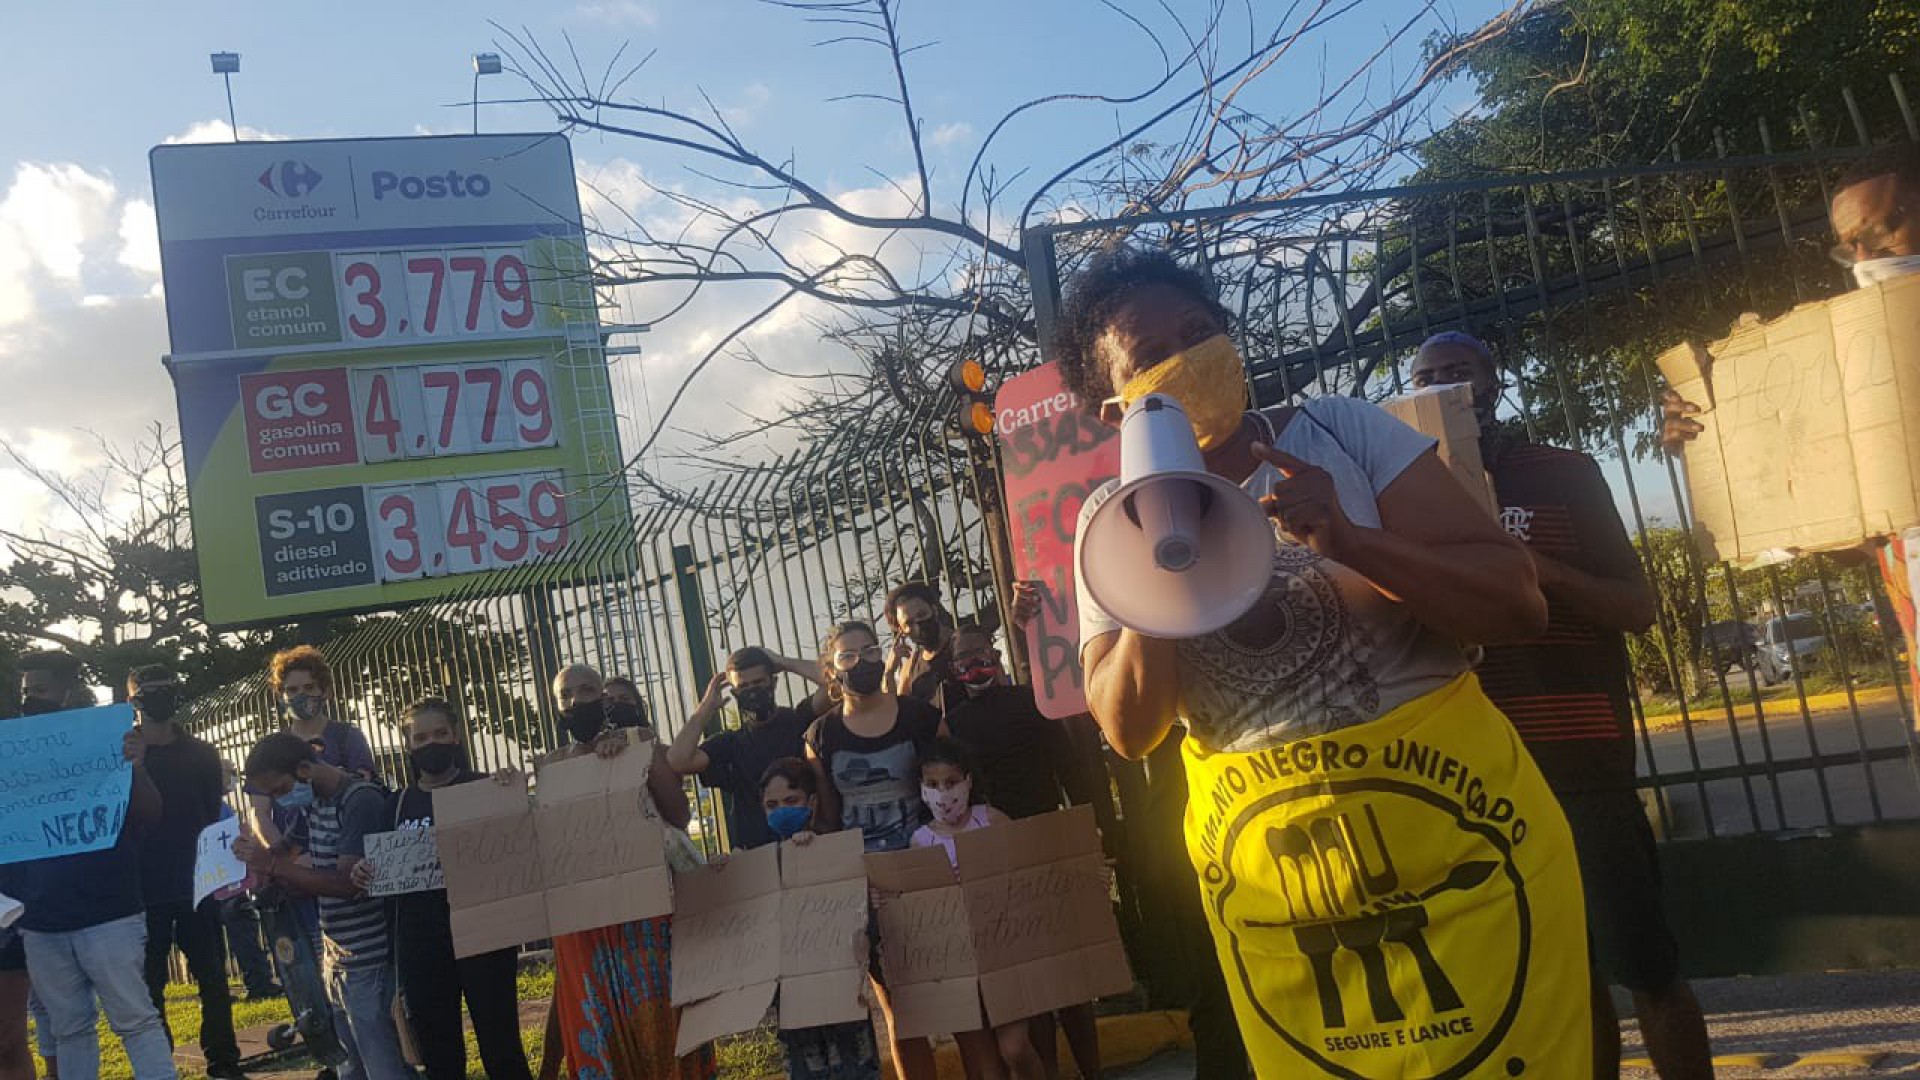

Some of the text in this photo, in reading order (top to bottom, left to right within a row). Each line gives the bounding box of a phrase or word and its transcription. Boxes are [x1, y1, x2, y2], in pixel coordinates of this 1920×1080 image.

[253, 169, 491, 222] Carrefour Posto
[241, 267, 308, 301] EC
[246, 304, 311, 323] etanol
[248, 319, 327, 337] comum
[255, 382, 328, 420] GC
[258, 420, 343, 445] gasolina
[261, 440, 341, 460] comum
[268, 502, 355, 540] S-10
[274, 540, 337, 564] diesel
[276, 560, 367, 583] aditivado
[1248, 739, 1369, 784] NEGRO
[1383, 738, 1528, 847] UNIFICADO
[1324, 1016, 1475, 1052] SEGURE E LANCE
